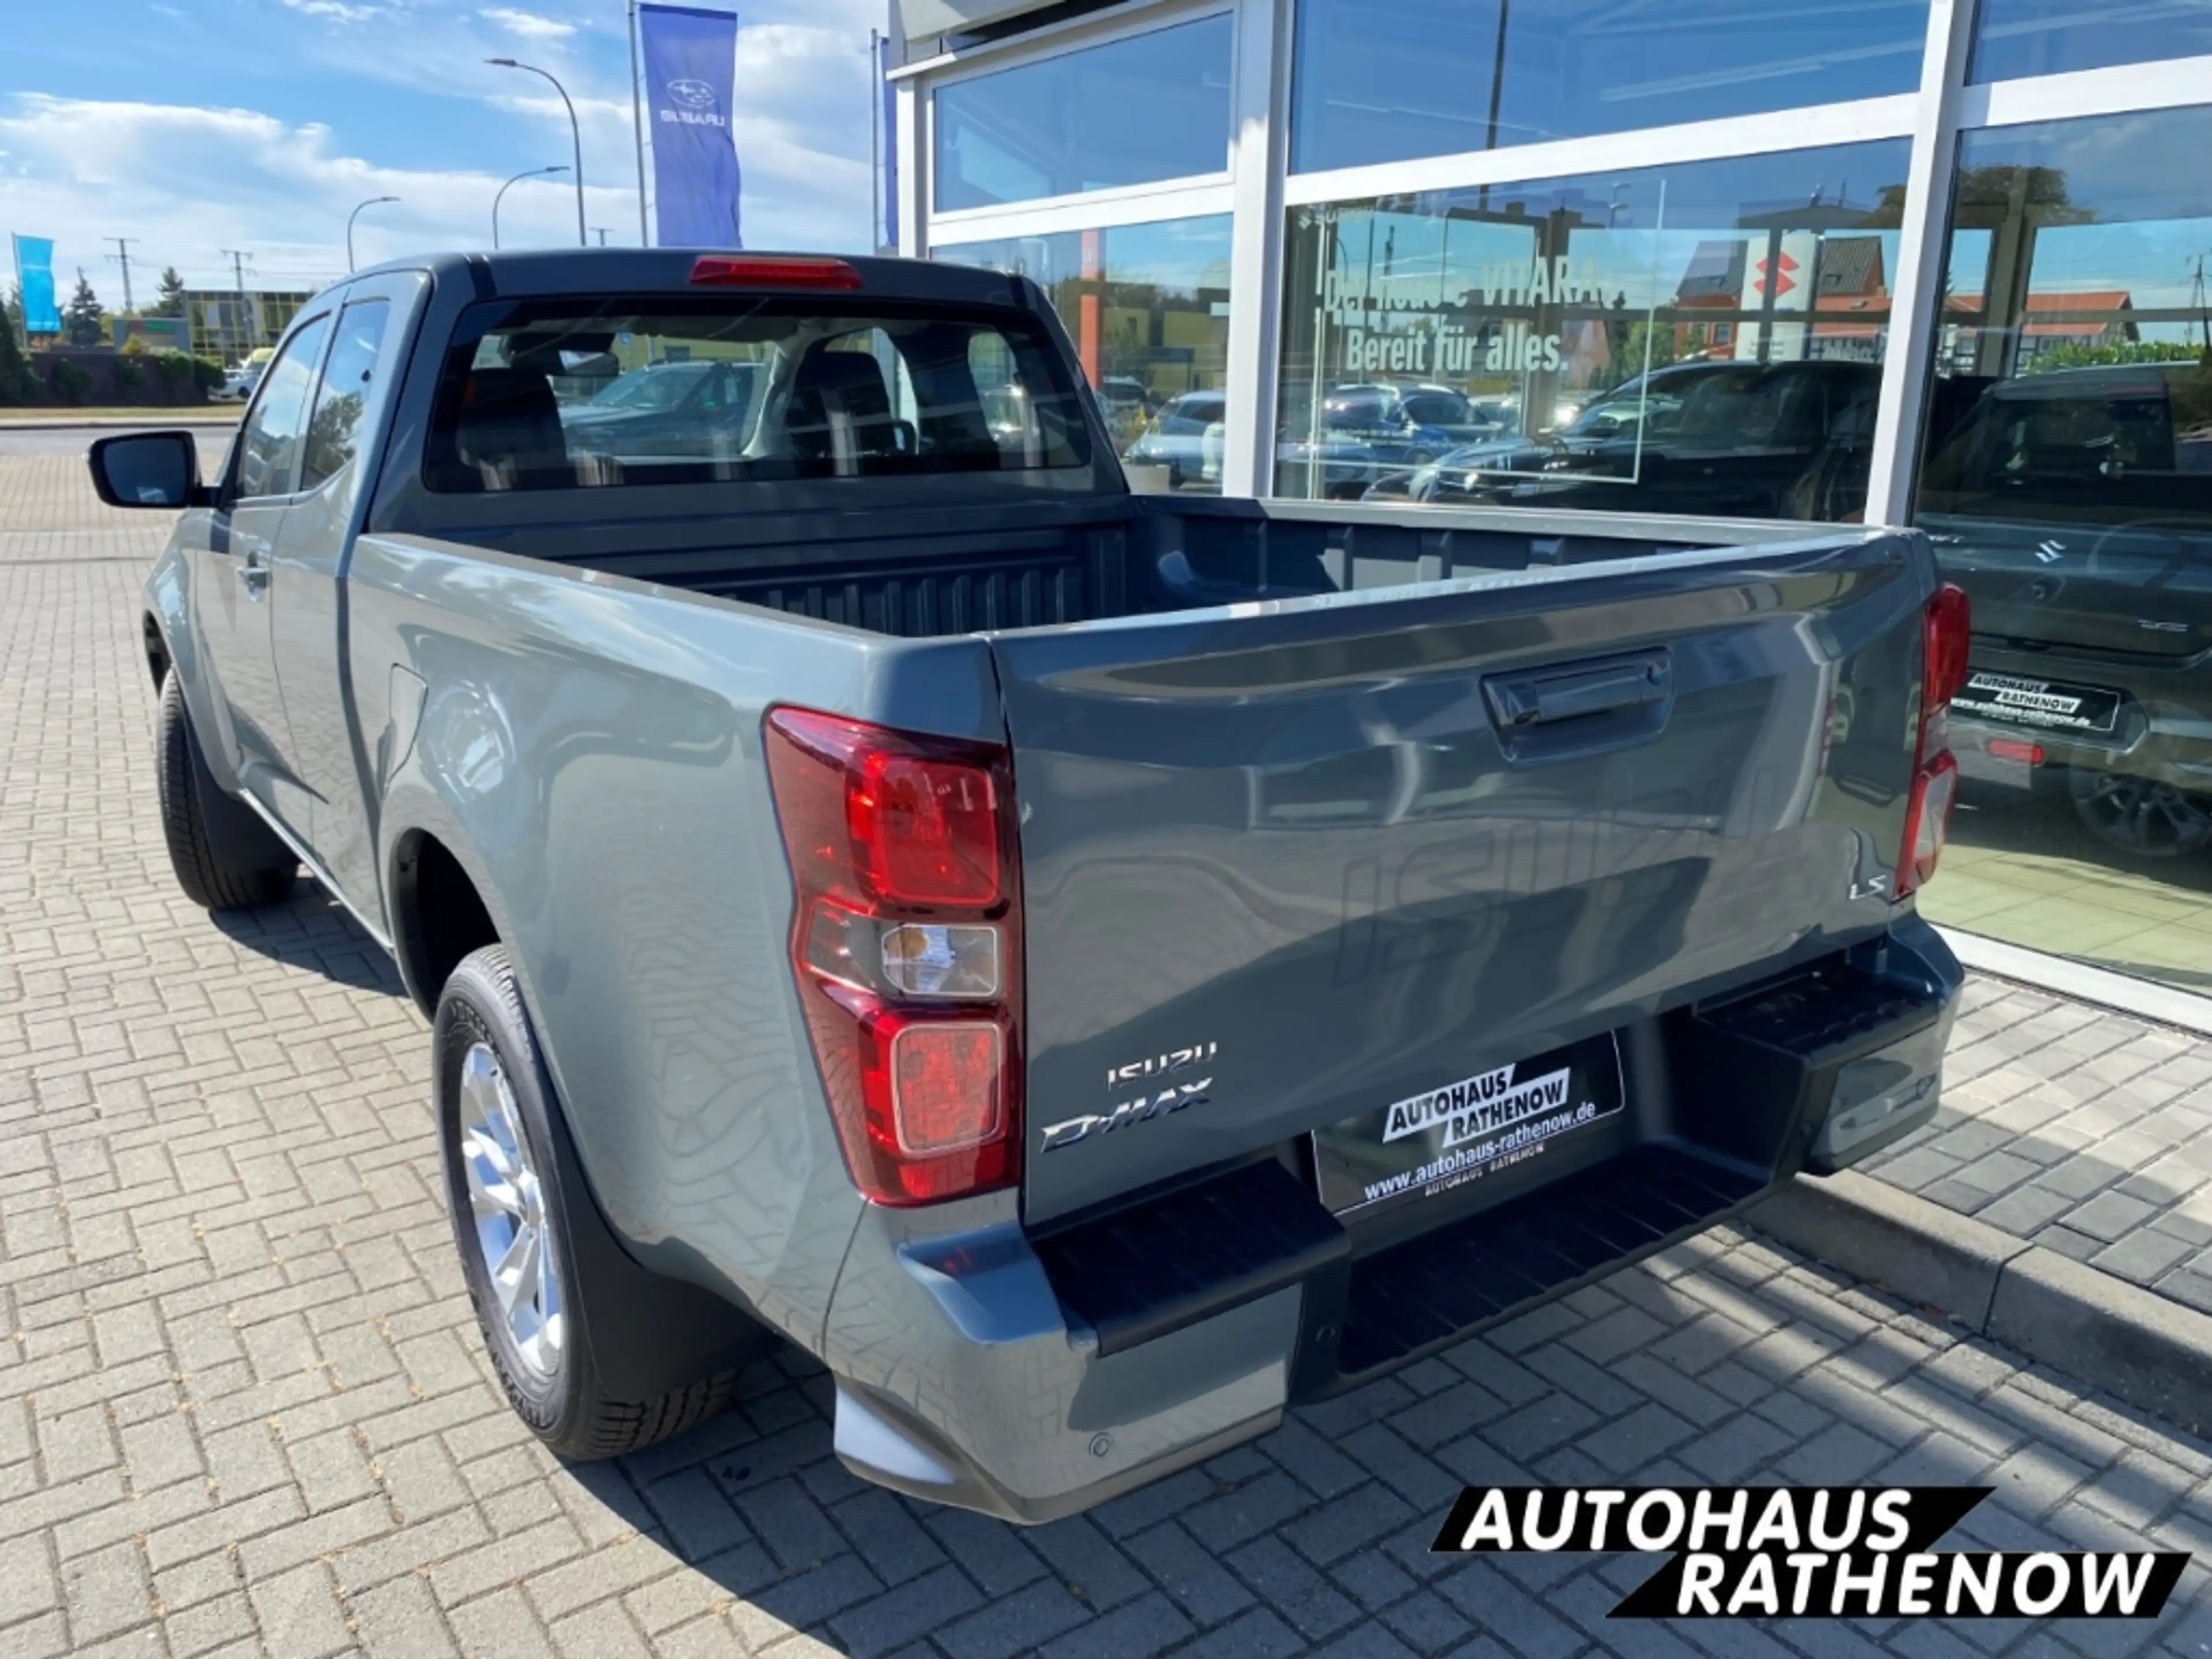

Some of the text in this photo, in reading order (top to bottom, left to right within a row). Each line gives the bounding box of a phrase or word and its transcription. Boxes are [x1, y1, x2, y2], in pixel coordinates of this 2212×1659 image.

[660, 110, 725, 127] SUBARU
[1346, 323, 1570, 372] Bereit für alles.
[1974, 675, 2043, 694] AUTOHAUS
[2001, 692, 2075, 711] RATHENOW
[1849, 874, 1887, 900] LS
[1107, 1041, 1217, 1090] ISUZU
[1390, 1070, 1508, 1133] AUTOHAUS
[1452, 1078, 1565, 1140] RATHENOW
[1364, 1101, 1597, 1200] www.autohaus-rathenow.de
